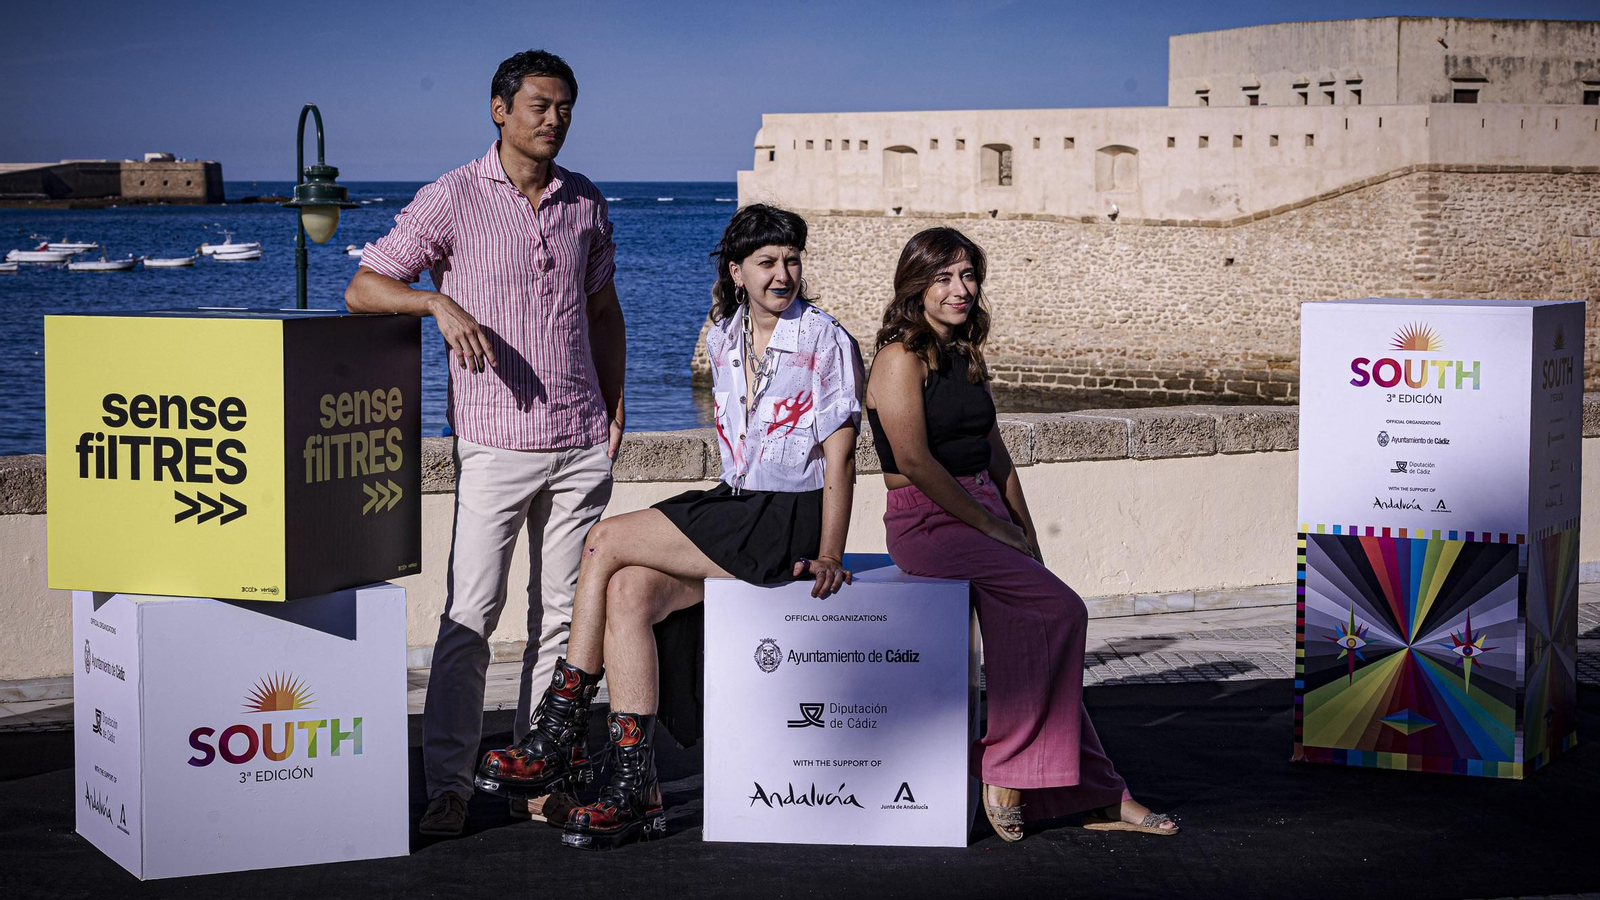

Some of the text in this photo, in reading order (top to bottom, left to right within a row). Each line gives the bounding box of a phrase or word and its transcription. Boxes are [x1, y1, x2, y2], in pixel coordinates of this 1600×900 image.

[1349, 357, 1481, 390] SOUTH
[1542, 356, 1573, 390] SOUTH
[319, 387, 403, 428] sense
[1386, 393, 1442, 404] 3ª EDICIÓN
[102, 393, 247, 431] sense
[1391, 436, 1426, 444] Ayuntamiento
[1434, 437, 1450, 445] Cádiz
[76, 431, 247, 485] filTRES
[303, 427, 403, 484] filTRES
[1372, 497, 1424, 512] Andalucía
[784, 614, 888, 622] OFFICIAL ORGANIZATIONS
[787, 649, 920, 665] Ayuntamiento de Cádiz
[829, 702, 888, 715] Diputación
[830, 717, 877, 729] de Cádiz
[187, 717, 363, 767] SOUTH
[793, 759, 882, 767] WITH THE SUPPORT OF
[239, 766, 314, 784] 3ª EDICIÓN
[748, 781, 866, 809] Andalucía
